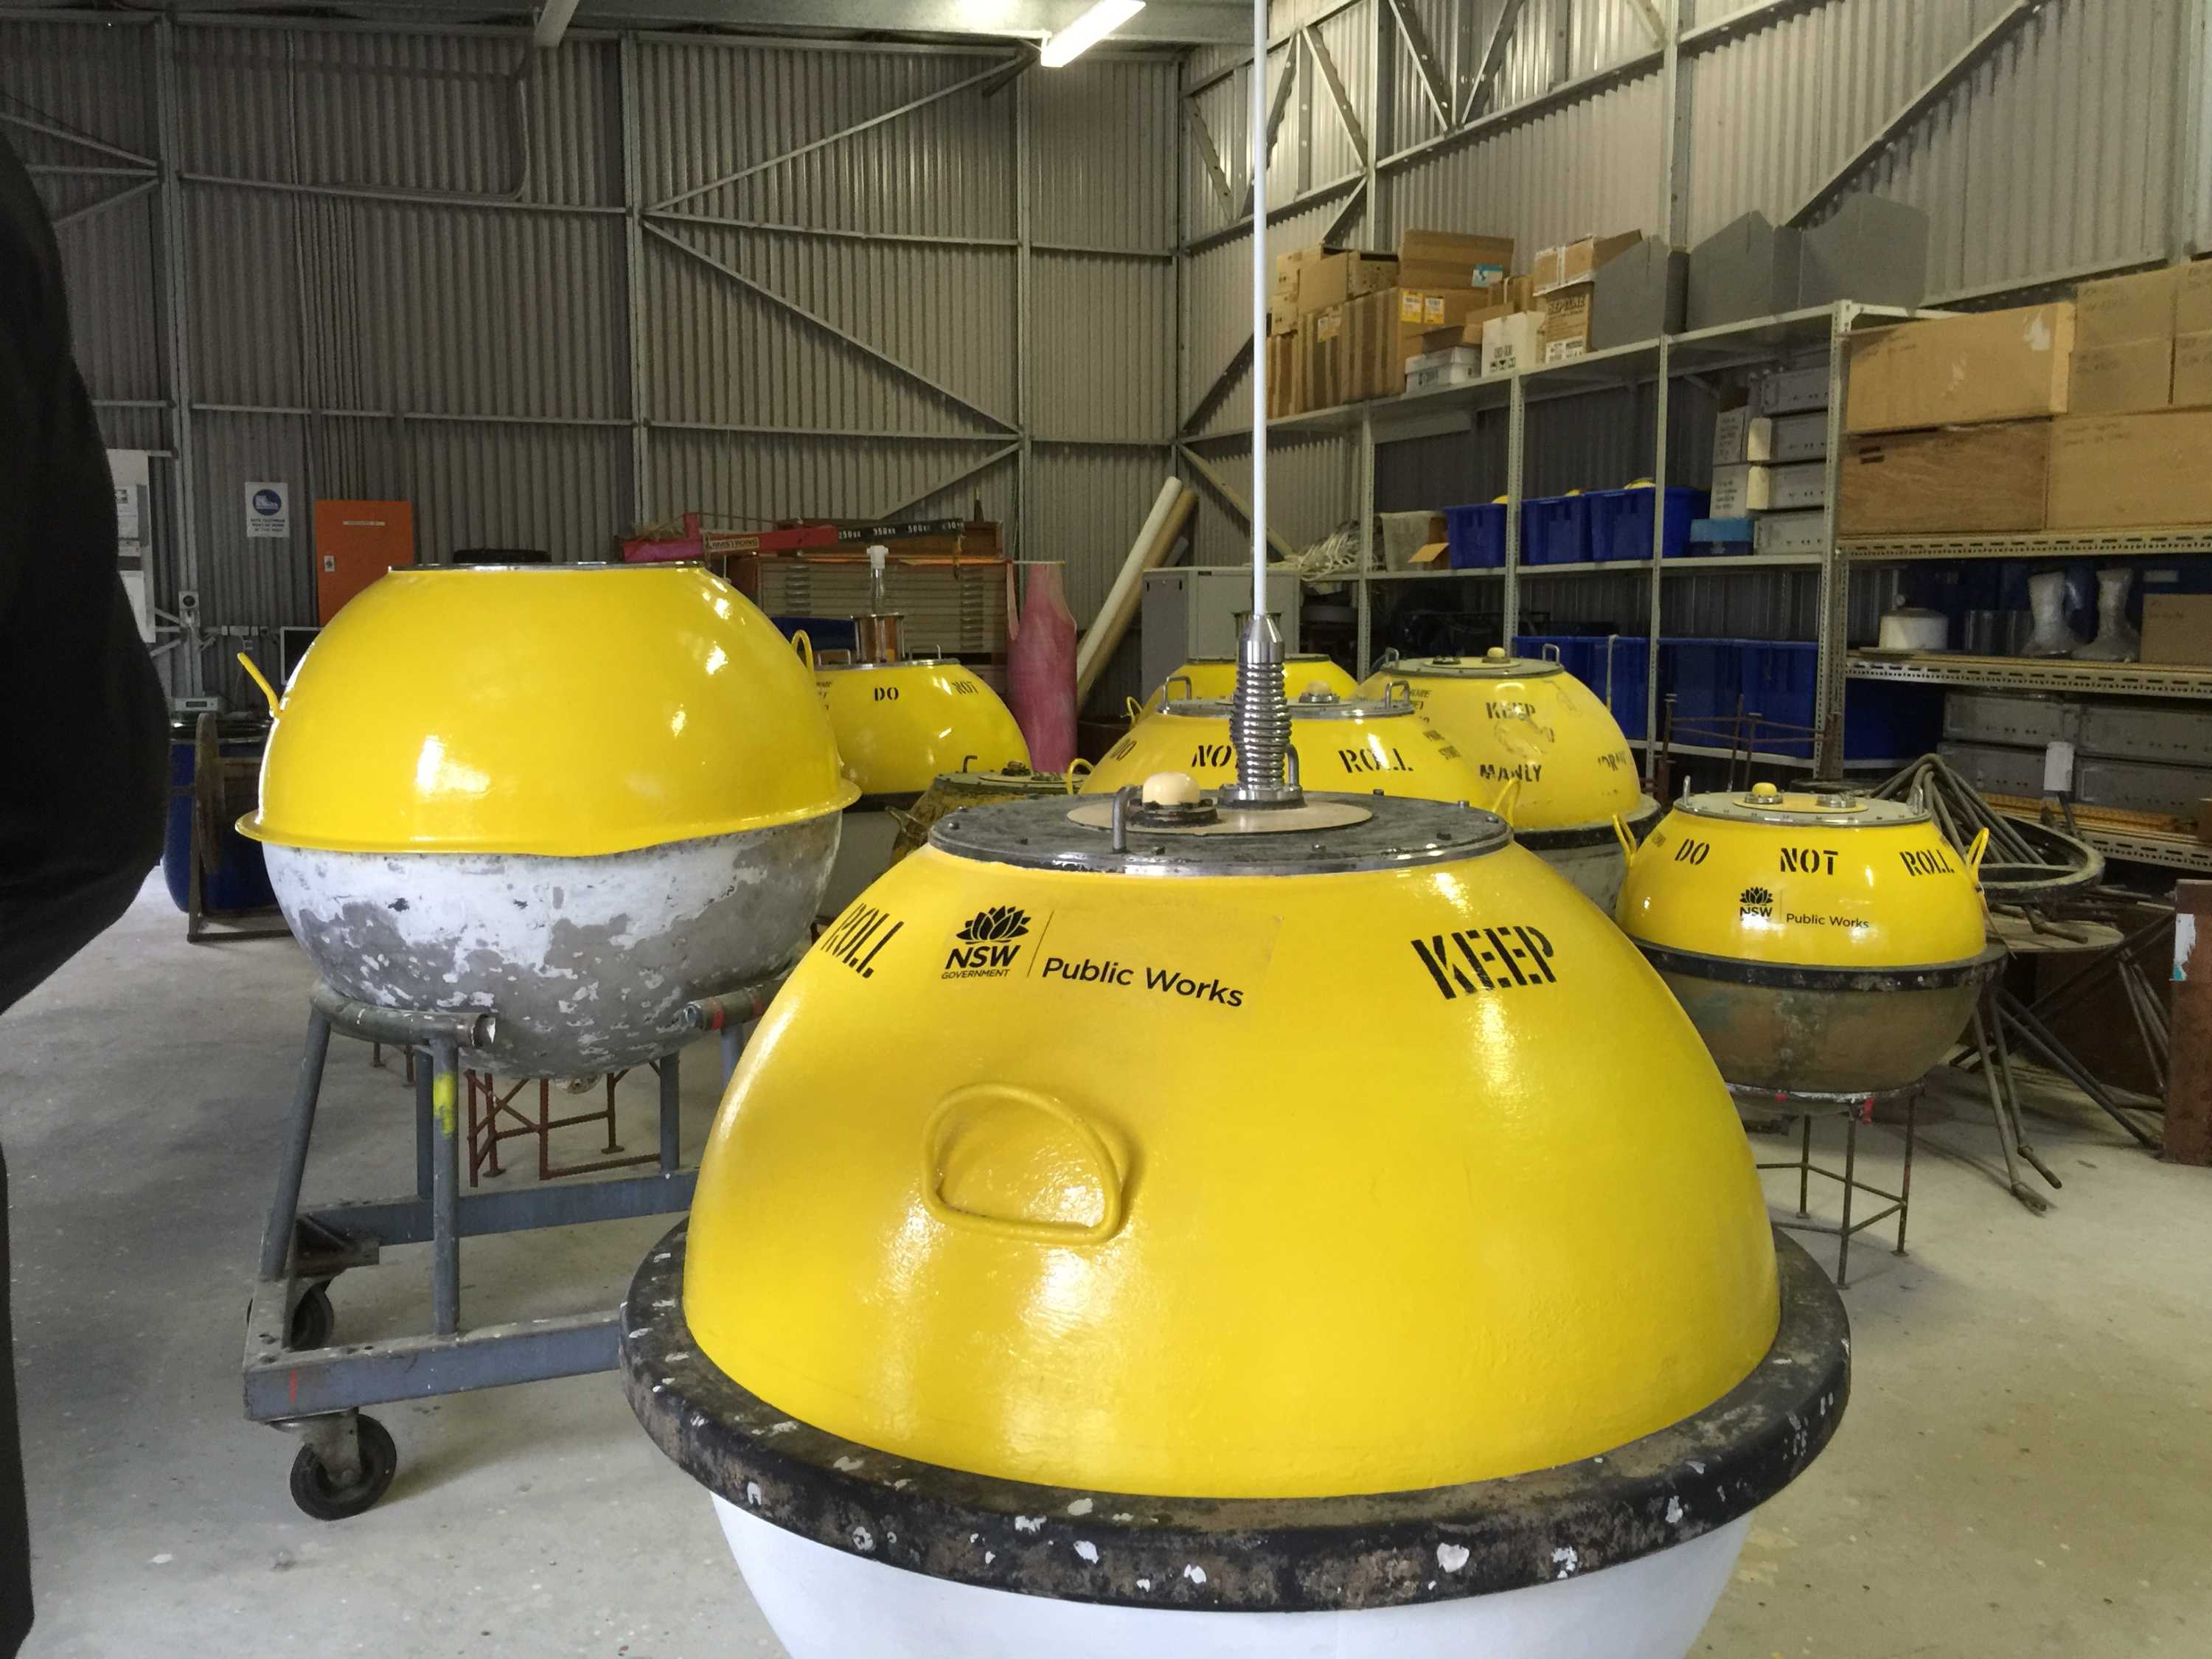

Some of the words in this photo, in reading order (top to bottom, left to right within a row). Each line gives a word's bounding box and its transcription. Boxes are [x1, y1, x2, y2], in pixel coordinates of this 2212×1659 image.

[874, 687, 899, 701] DO
[1192, 745, 1239, 768] NO
[1480, 765, 1541, 782] MANLY
[1674, 838, 1711, 866] DO
[1781, 848, 1838, 875] NOT
[1899, 849, 1955, 877] ROLL
[1739, 906, 1773, 918] NSW
[1786, 913, 1826, 925] Public
[1829, 916, 1869, 928] Works
[820, 902, 905, 979] ROLL
[945, 945, 1021, 970] NSW
[1411, 926, 1557, 1000] KEEP
[941, 969, 1010, 980] GOVERNMENT
[1042, 957, 1135, 986] Public
[1146, 967, 1244, 1007] Works
